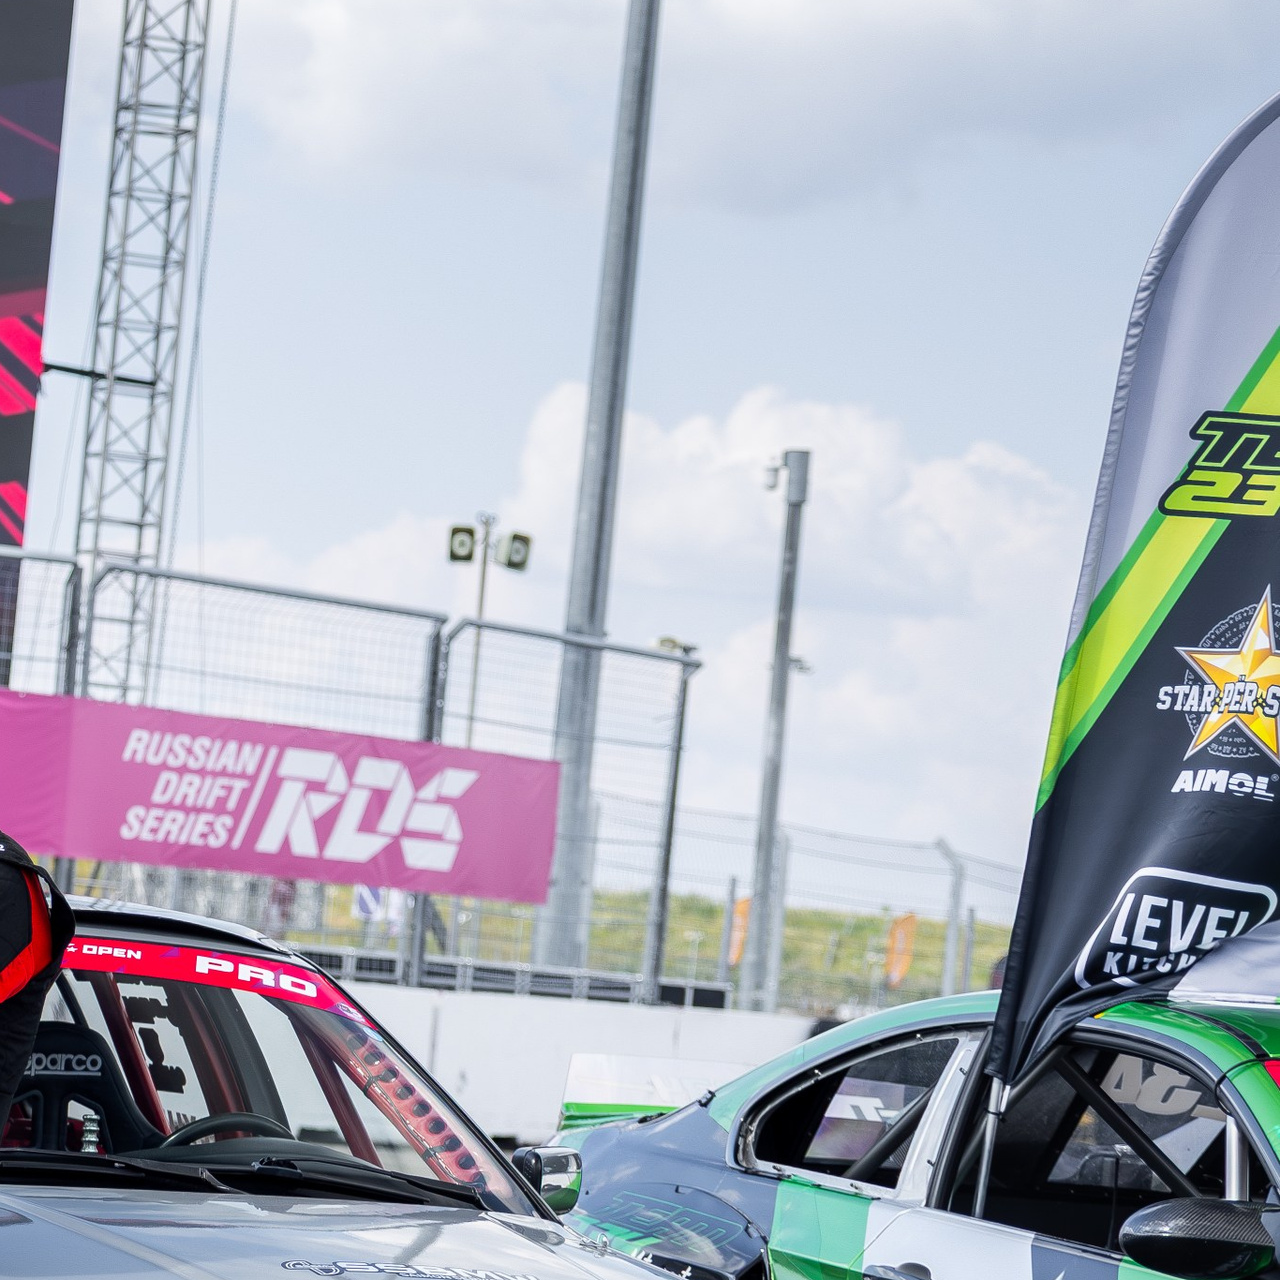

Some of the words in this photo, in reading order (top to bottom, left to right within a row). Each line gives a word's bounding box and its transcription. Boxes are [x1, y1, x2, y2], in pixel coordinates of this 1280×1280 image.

[1156, 685, 1217, 713] STAR
[121, 727, 265, 776] RUSSIAN
[150, 770, 252, 812] DRIFT
[1171, 769, 1275, 802] AIMOL
[120, 805, 234, 849] SERIES
[254, 746, 482, 873] RDS
[82, 944, 142, 960] OPEN
[195, 955, 317, 998] PRO
